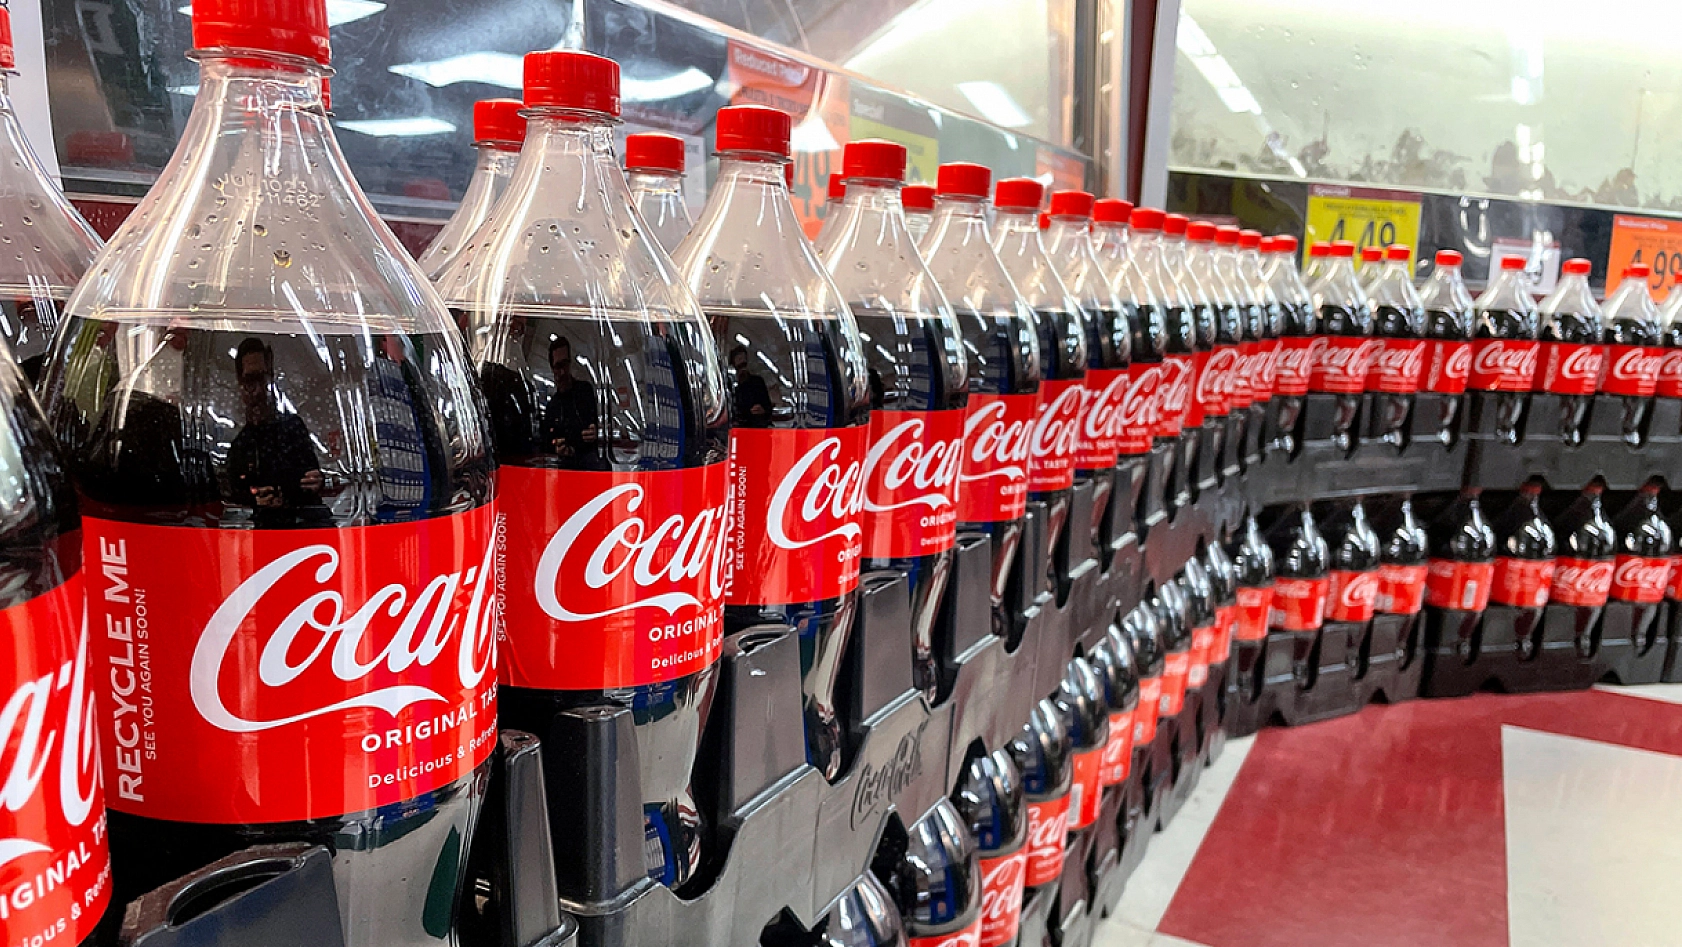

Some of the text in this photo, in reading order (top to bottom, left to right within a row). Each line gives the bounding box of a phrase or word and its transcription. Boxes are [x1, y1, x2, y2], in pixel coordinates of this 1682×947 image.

[648, 610, 718, 642] ORIGINAL
[100, 536, 144, 802] RECYCLE ME
[134, 588, 157, 760] SEE YOU AGAIN SOON!
[651, 648, 704, 669] Delicious
[361, 702, 477, 752] ORIGINAL
[368, 754, 453, 788] Delicious
[456, 745, 465, 759] &
